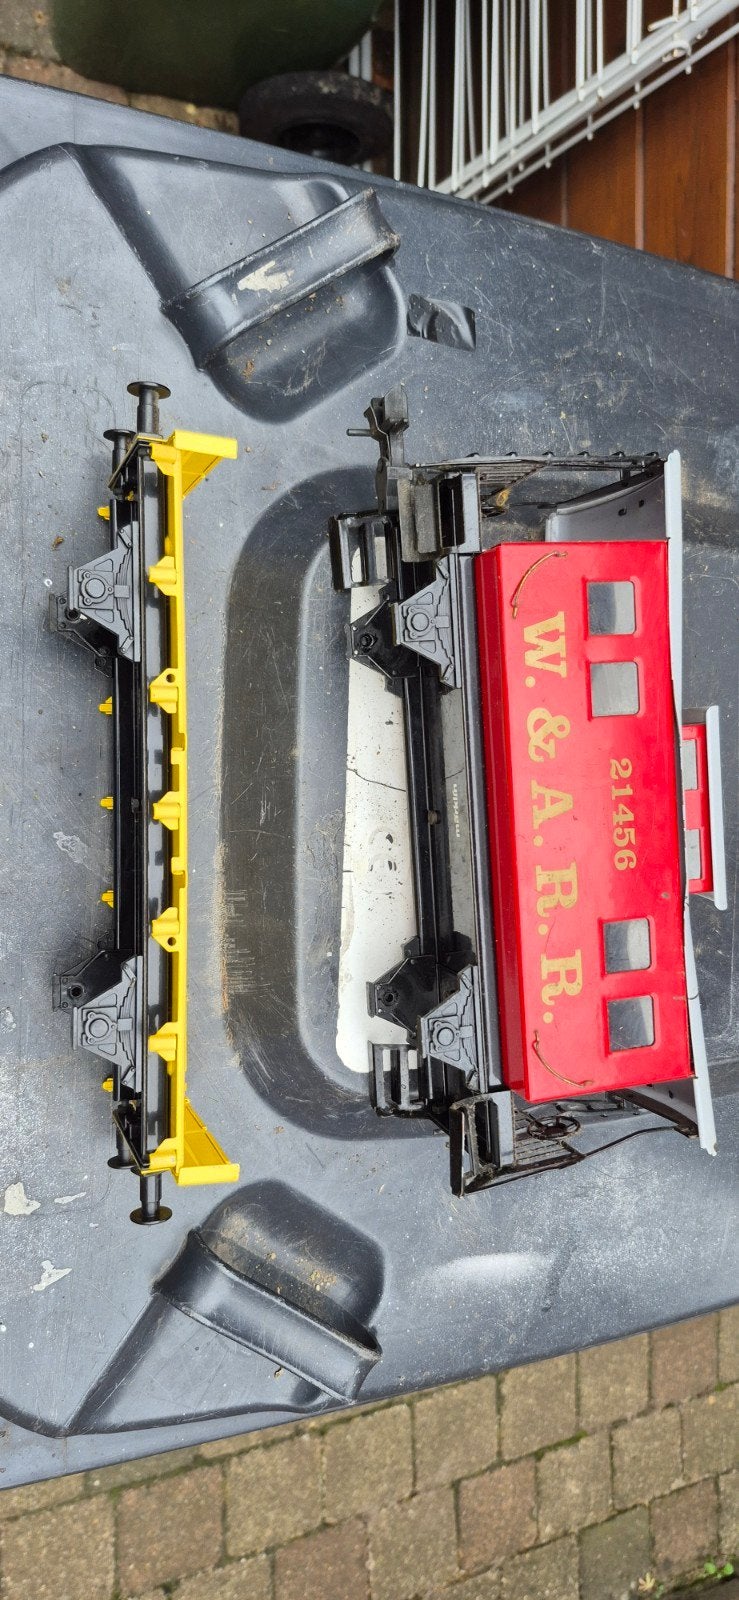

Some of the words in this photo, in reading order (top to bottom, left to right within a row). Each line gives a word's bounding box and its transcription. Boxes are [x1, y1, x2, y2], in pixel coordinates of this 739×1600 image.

[523, 611, 567, 689] W.
[526, 707, 571, 763] &
[530, 779, 574, 847] A.
[609, 757, 637, 872] 21456
[535, 861, 578, 936] R.
[540, 948, 583, 1024] R.
